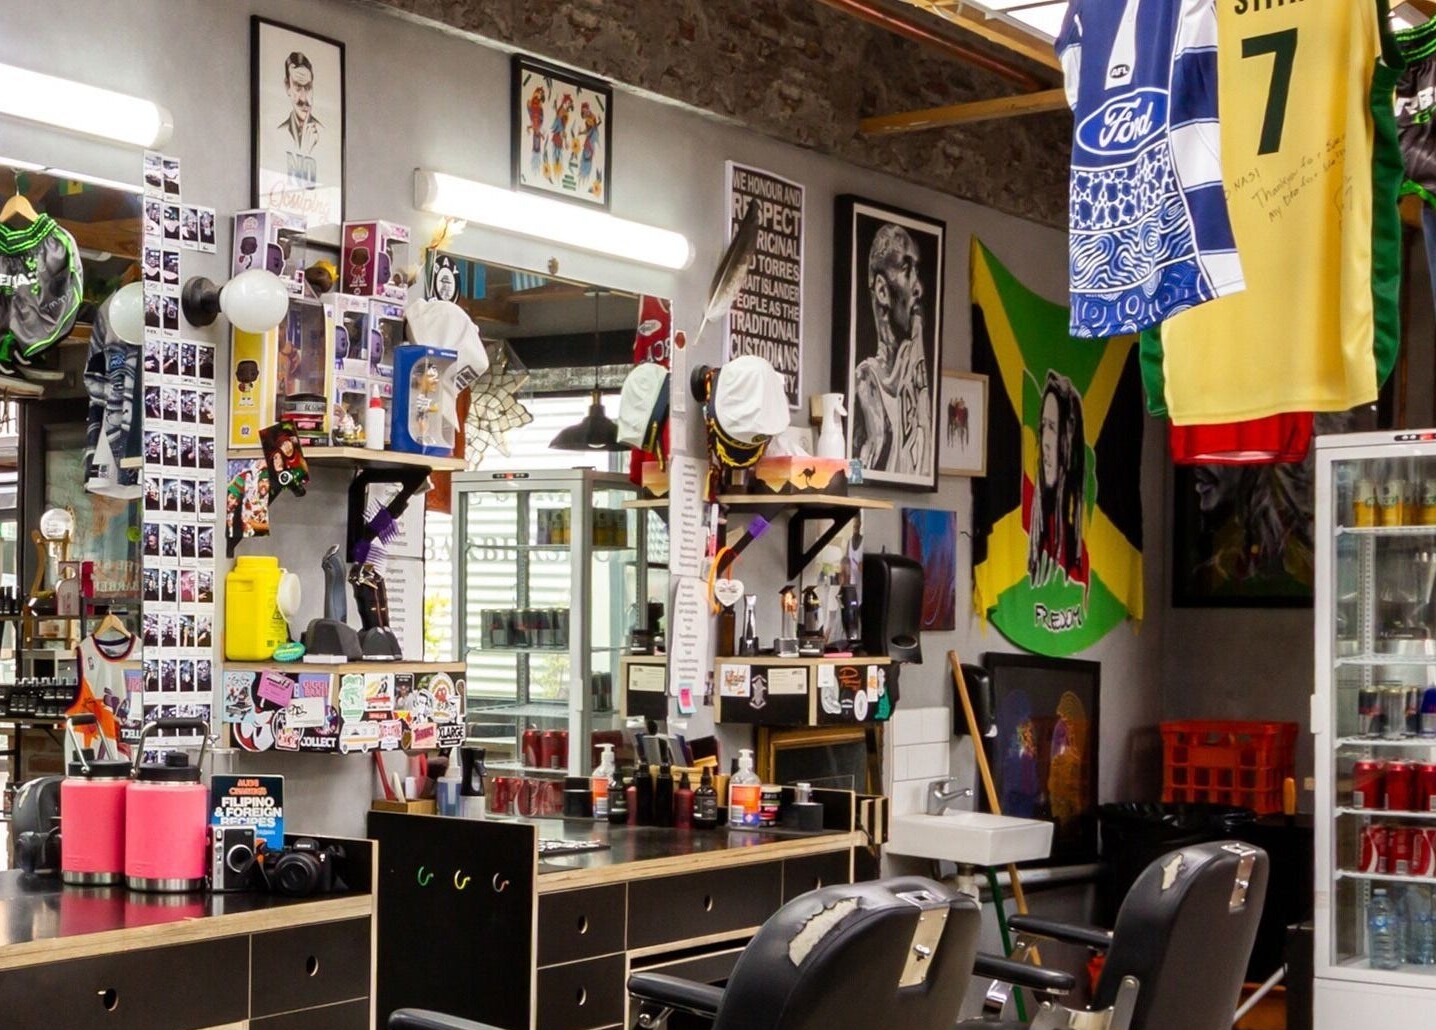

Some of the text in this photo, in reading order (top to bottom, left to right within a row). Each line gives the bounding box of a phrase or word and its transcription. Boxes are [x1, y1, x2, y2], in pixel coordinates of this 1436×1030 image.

[1111, 65, 1129, 77] AFL
[1241, 27, 1298, 155] 7
[1099, 97, 1154, 148] Ford
[733, 169, 801, 207] WE HONOUR AND
[732, 223, 800, 260] ARIGINAL
[758, 254, 800, 282] TORRES
[761, 278, 799, 302] ISLANDER
[737, 292, 799, 320] EOPLE AS THE
[731, 309, 799, 343] TRADITIONAL
[731, 333, 799, 372] CUSTODIANS
[438, 724, 464, 739] XLARGE
[214, 807, 283, 818] & FOREIGN
[221, 796, 274, 808] FILIPINO
[221, 817, 276, 828] RECIPES
